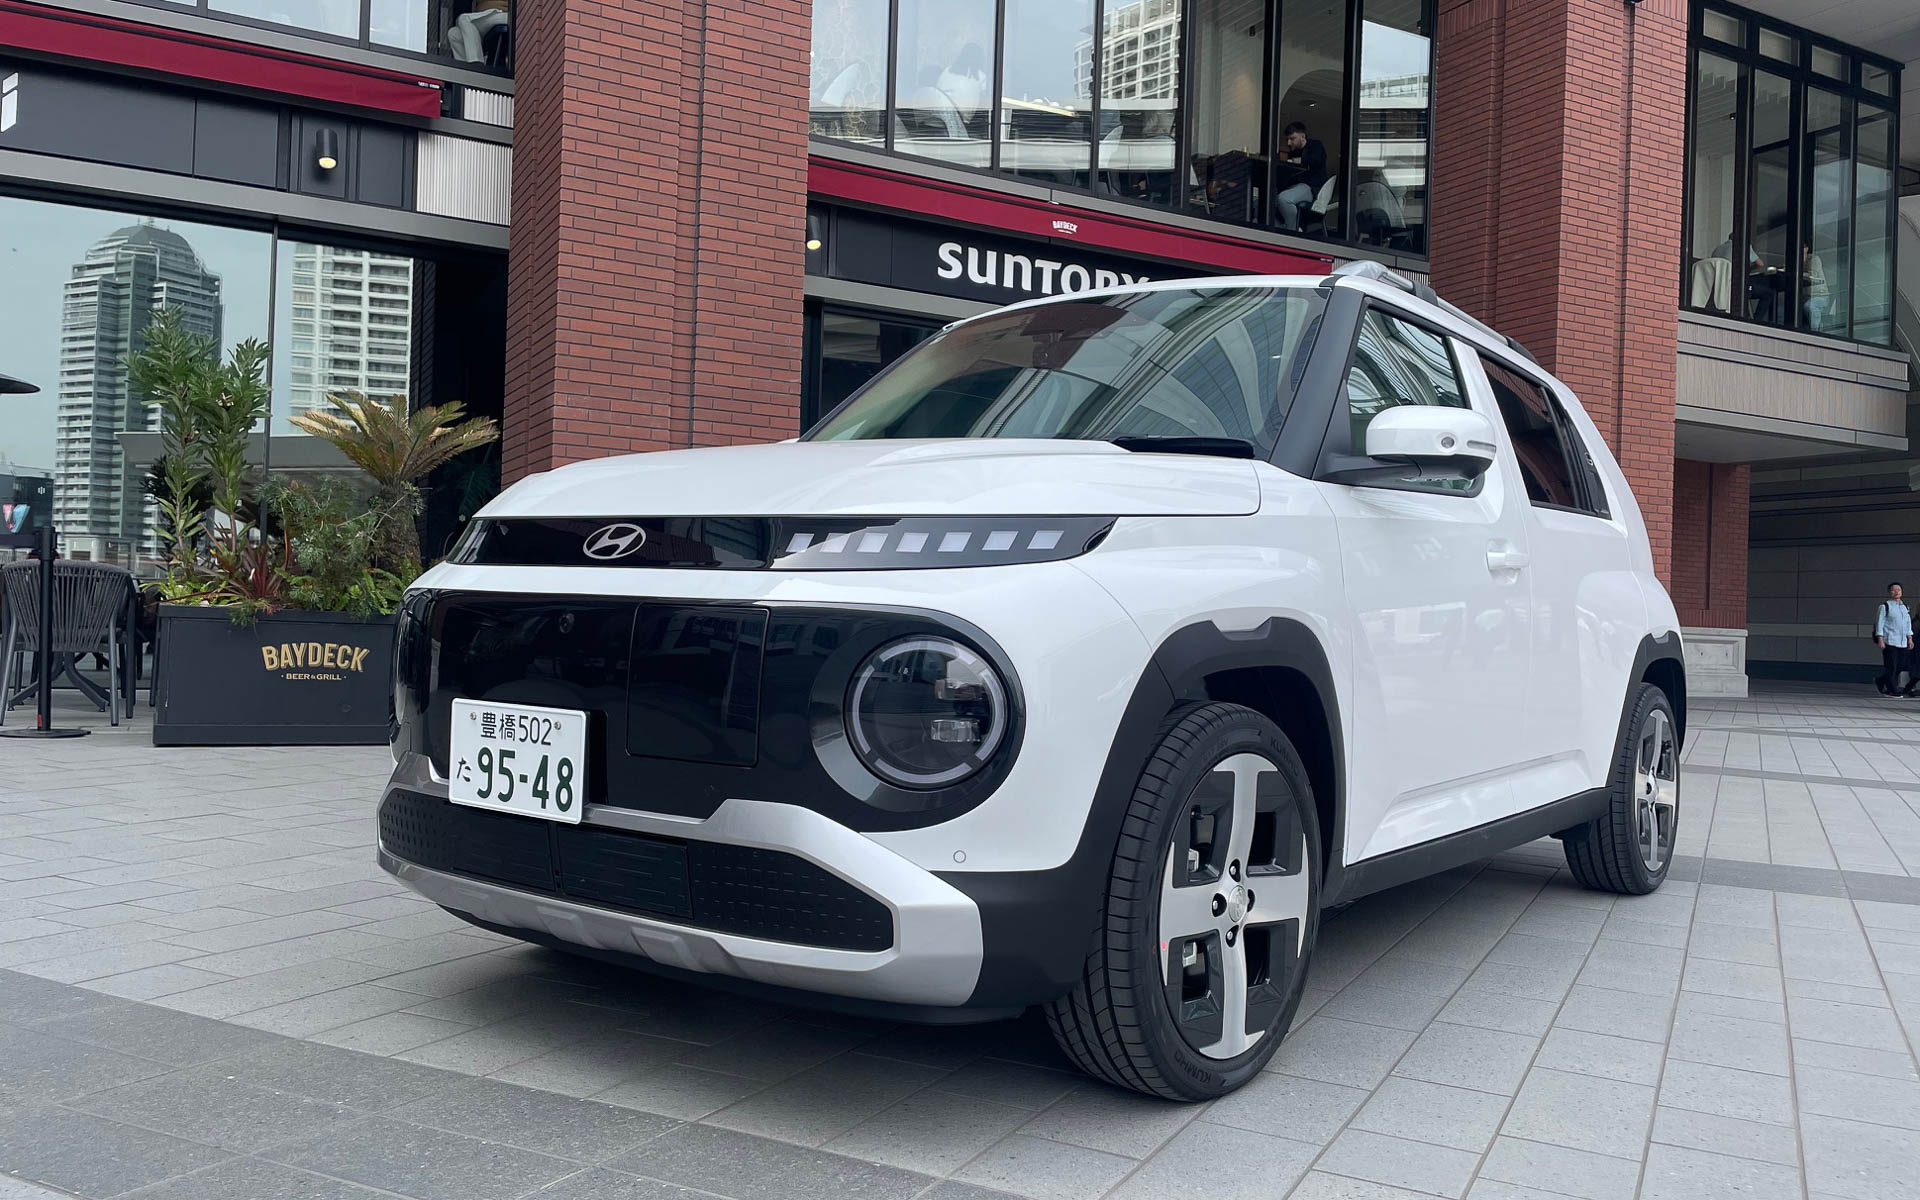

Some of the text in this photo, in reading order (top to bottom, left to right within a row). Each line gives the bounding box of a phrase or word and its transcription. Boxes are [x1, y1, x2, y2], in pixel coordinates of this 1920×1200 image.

[262, 642, 370, 672] BAYDECK
[480, 711, 552, 746] 豊橋502
[456, 746, 574, 812] た 95-48
[1174, 1049, 1212, 1084] KUMHO
